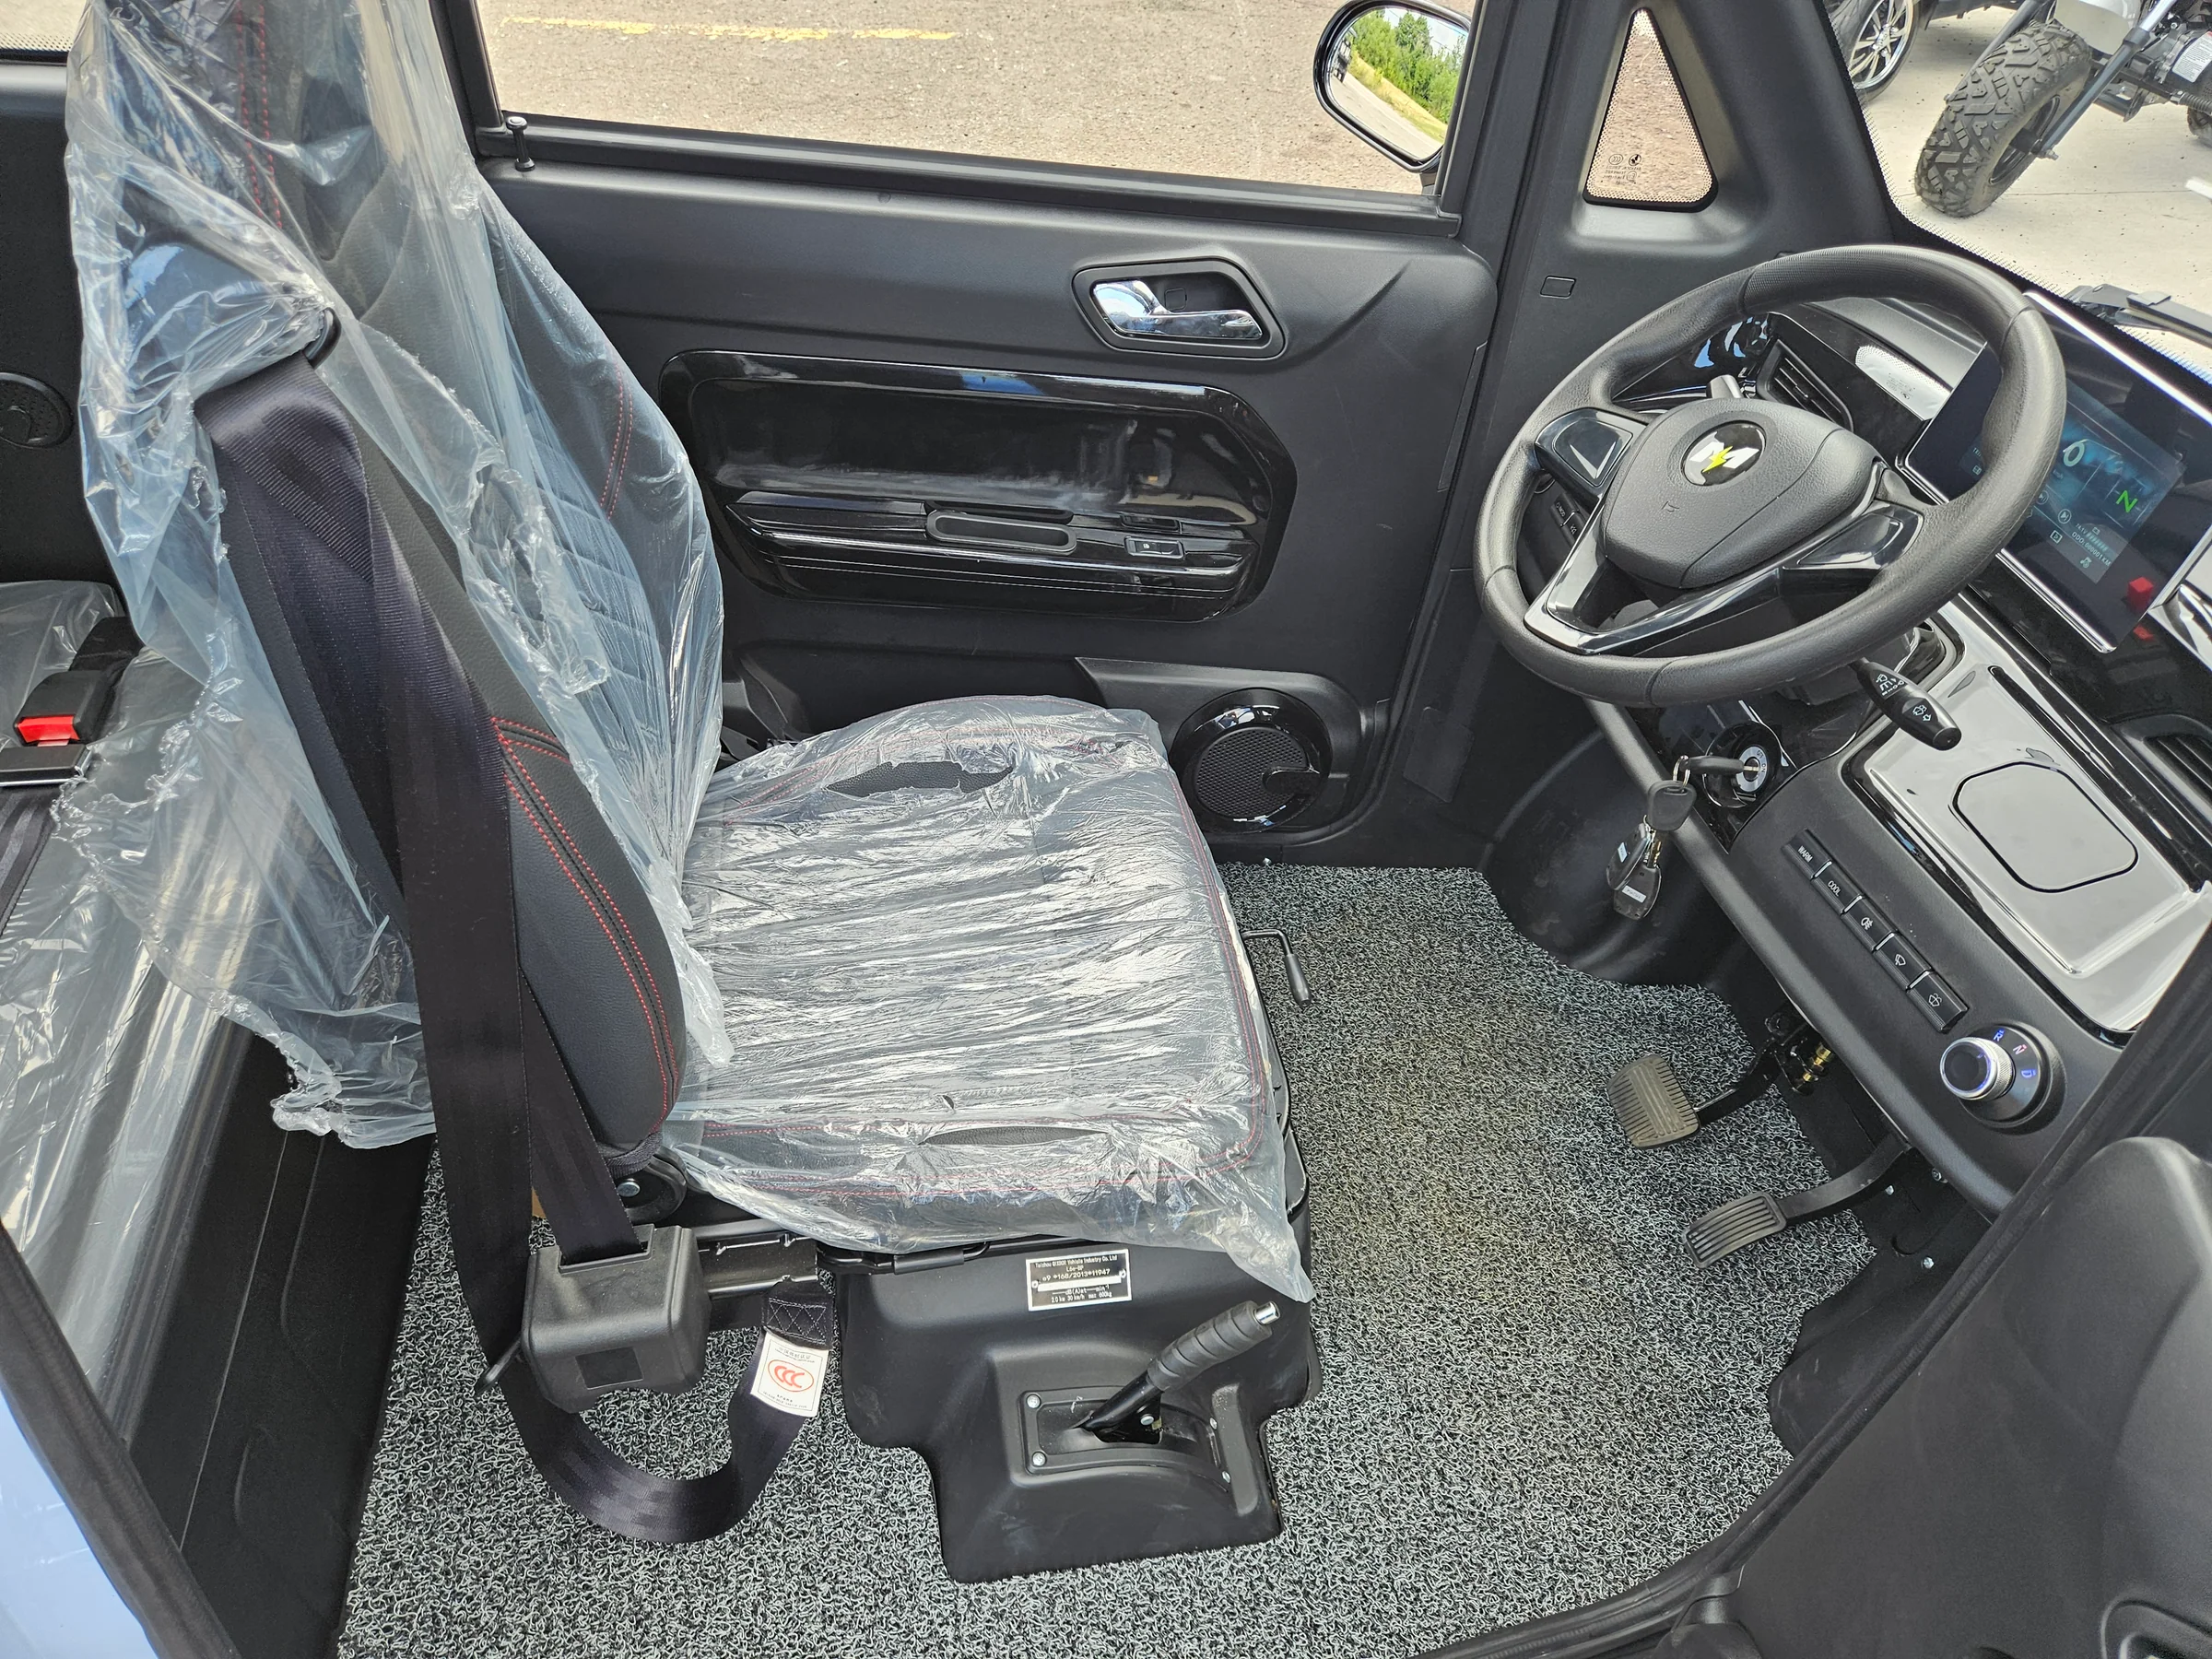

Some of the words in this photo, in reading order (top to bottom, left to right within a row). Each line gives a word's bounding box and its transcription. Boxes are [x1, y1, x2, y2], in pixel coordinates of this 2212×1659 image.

[2115, 489, 2138, 513] N
[1797, 845, 1813, 863] WARM
[1827, 880, 1841, 897] COOL
[2013, 1044, 2025, 1054] N
[774, 1365, 805, 1389] CCC
